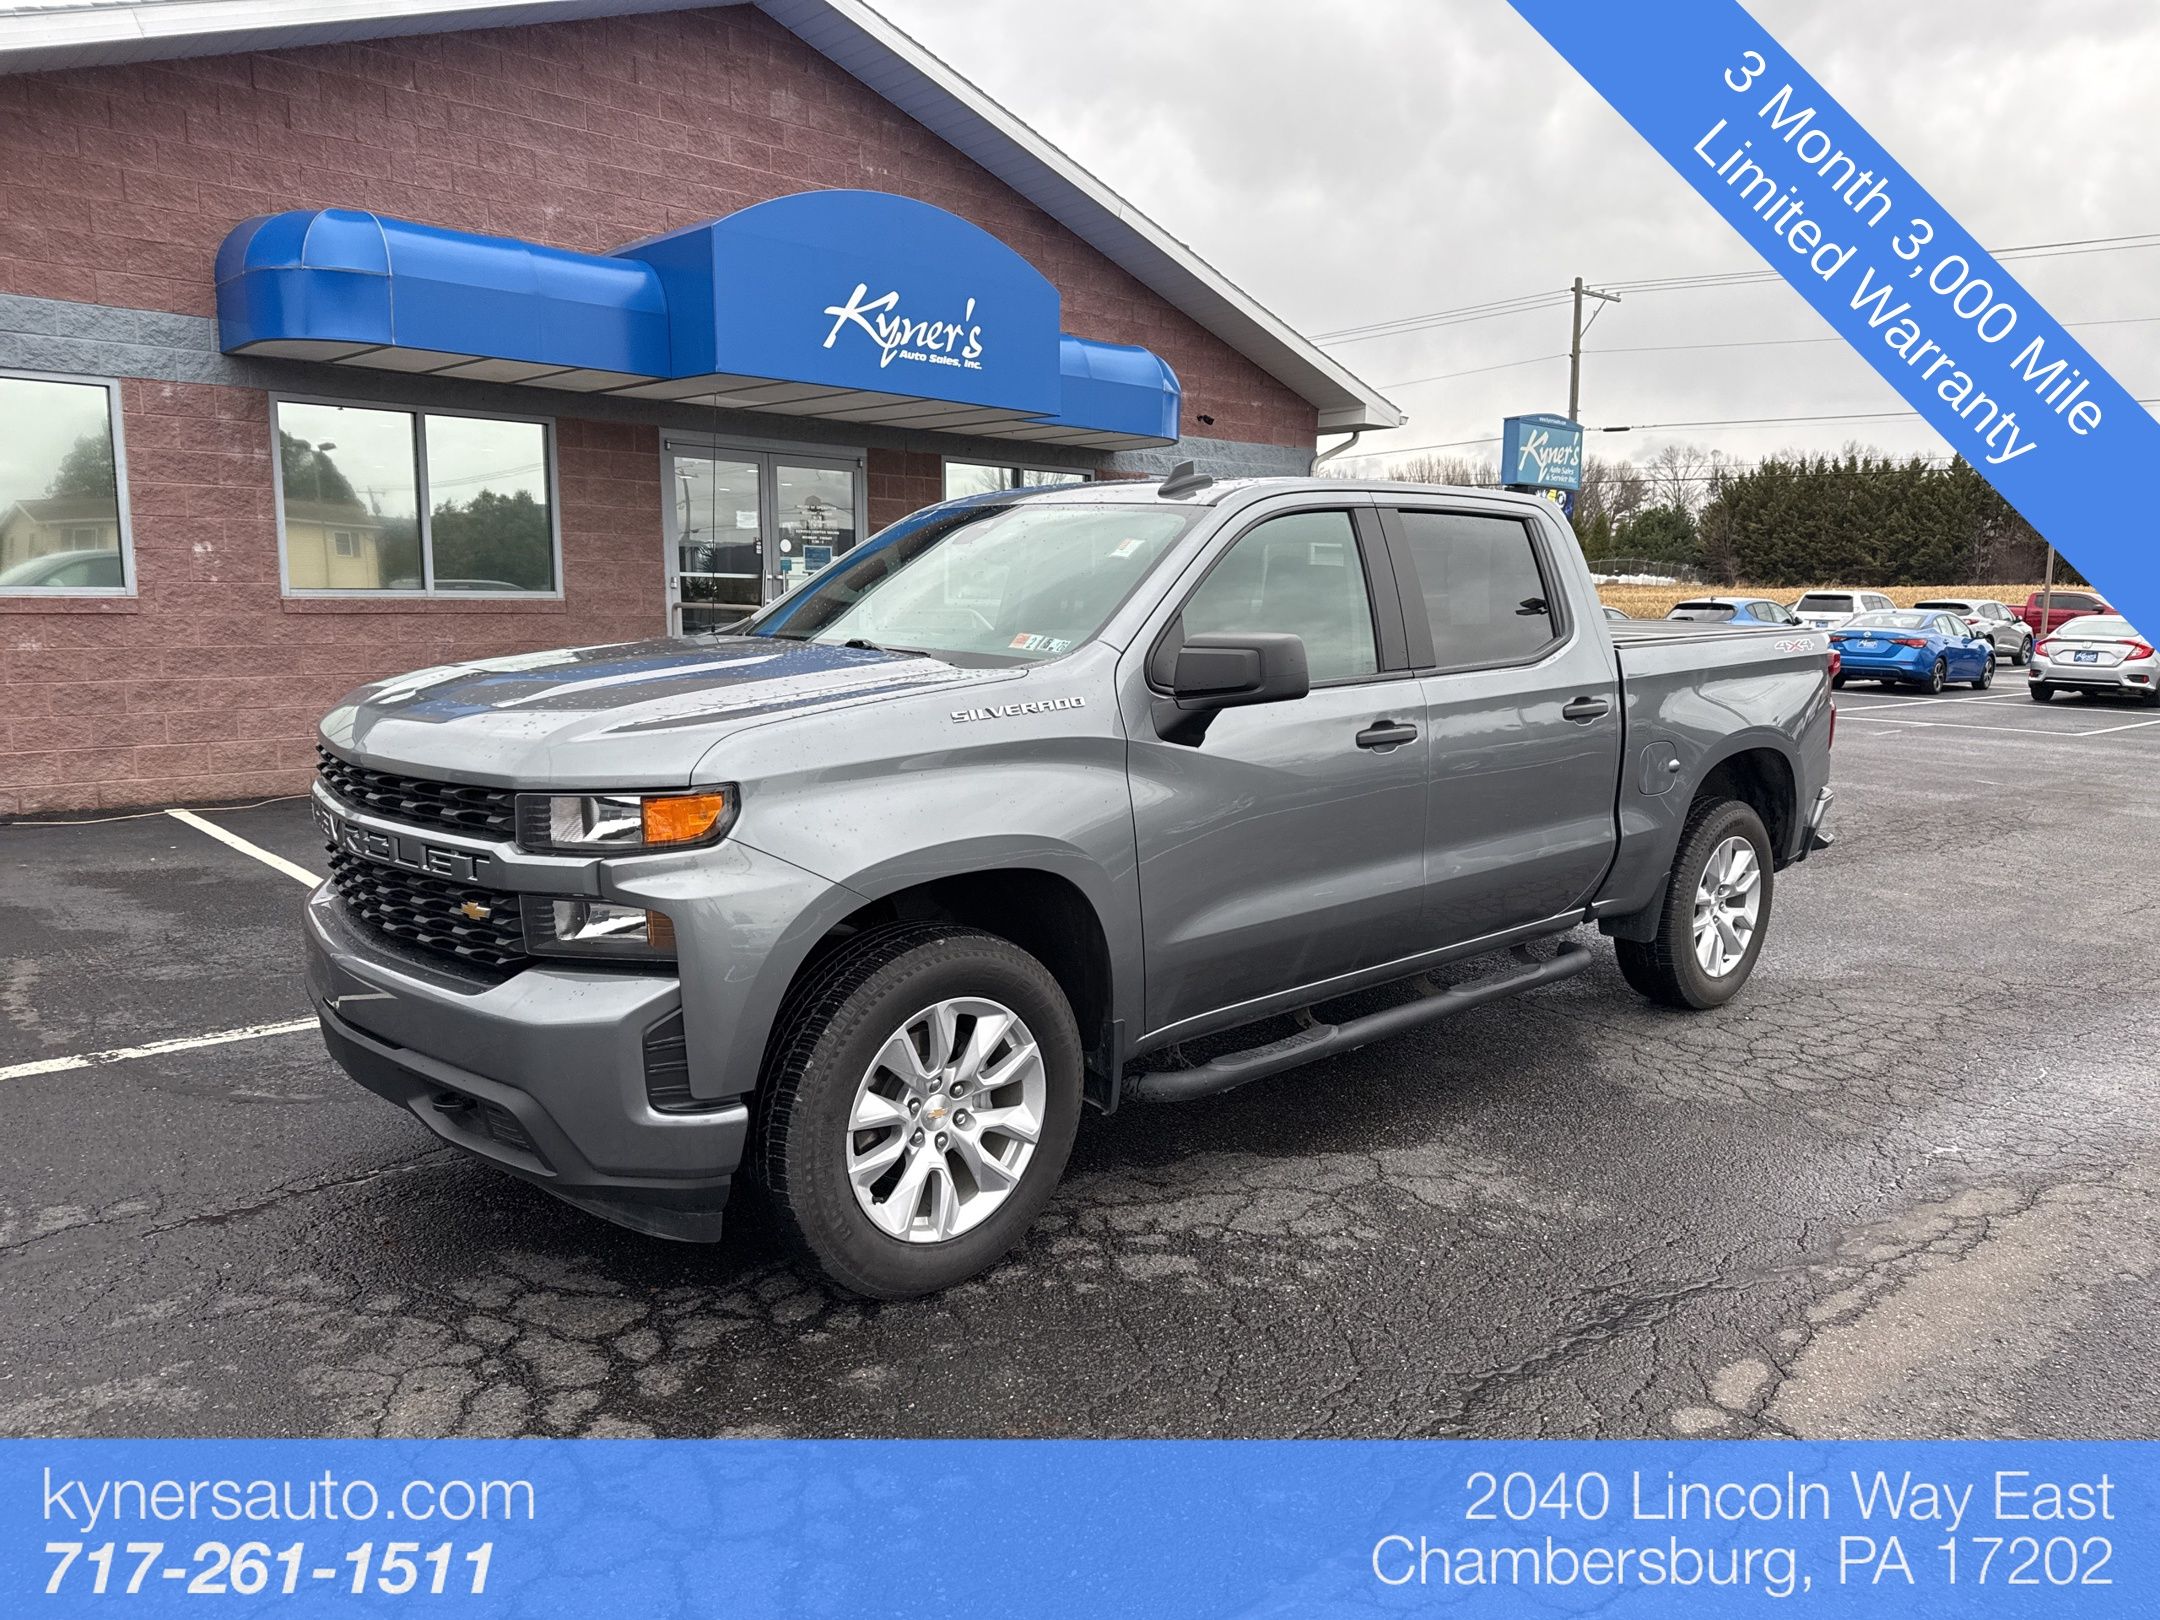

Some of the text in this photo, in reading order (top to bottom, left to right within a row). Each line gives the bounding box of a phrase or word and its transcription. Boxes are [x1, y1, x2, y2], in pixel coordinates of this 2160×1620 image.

[823, 283, 983, 368] Kyner's
[899, 350, 982, 370] Auto Sales, Inc.
[1518, 429, 1580, 483] Kyner's
[951, 696, 1086, 723] SILVERADO
